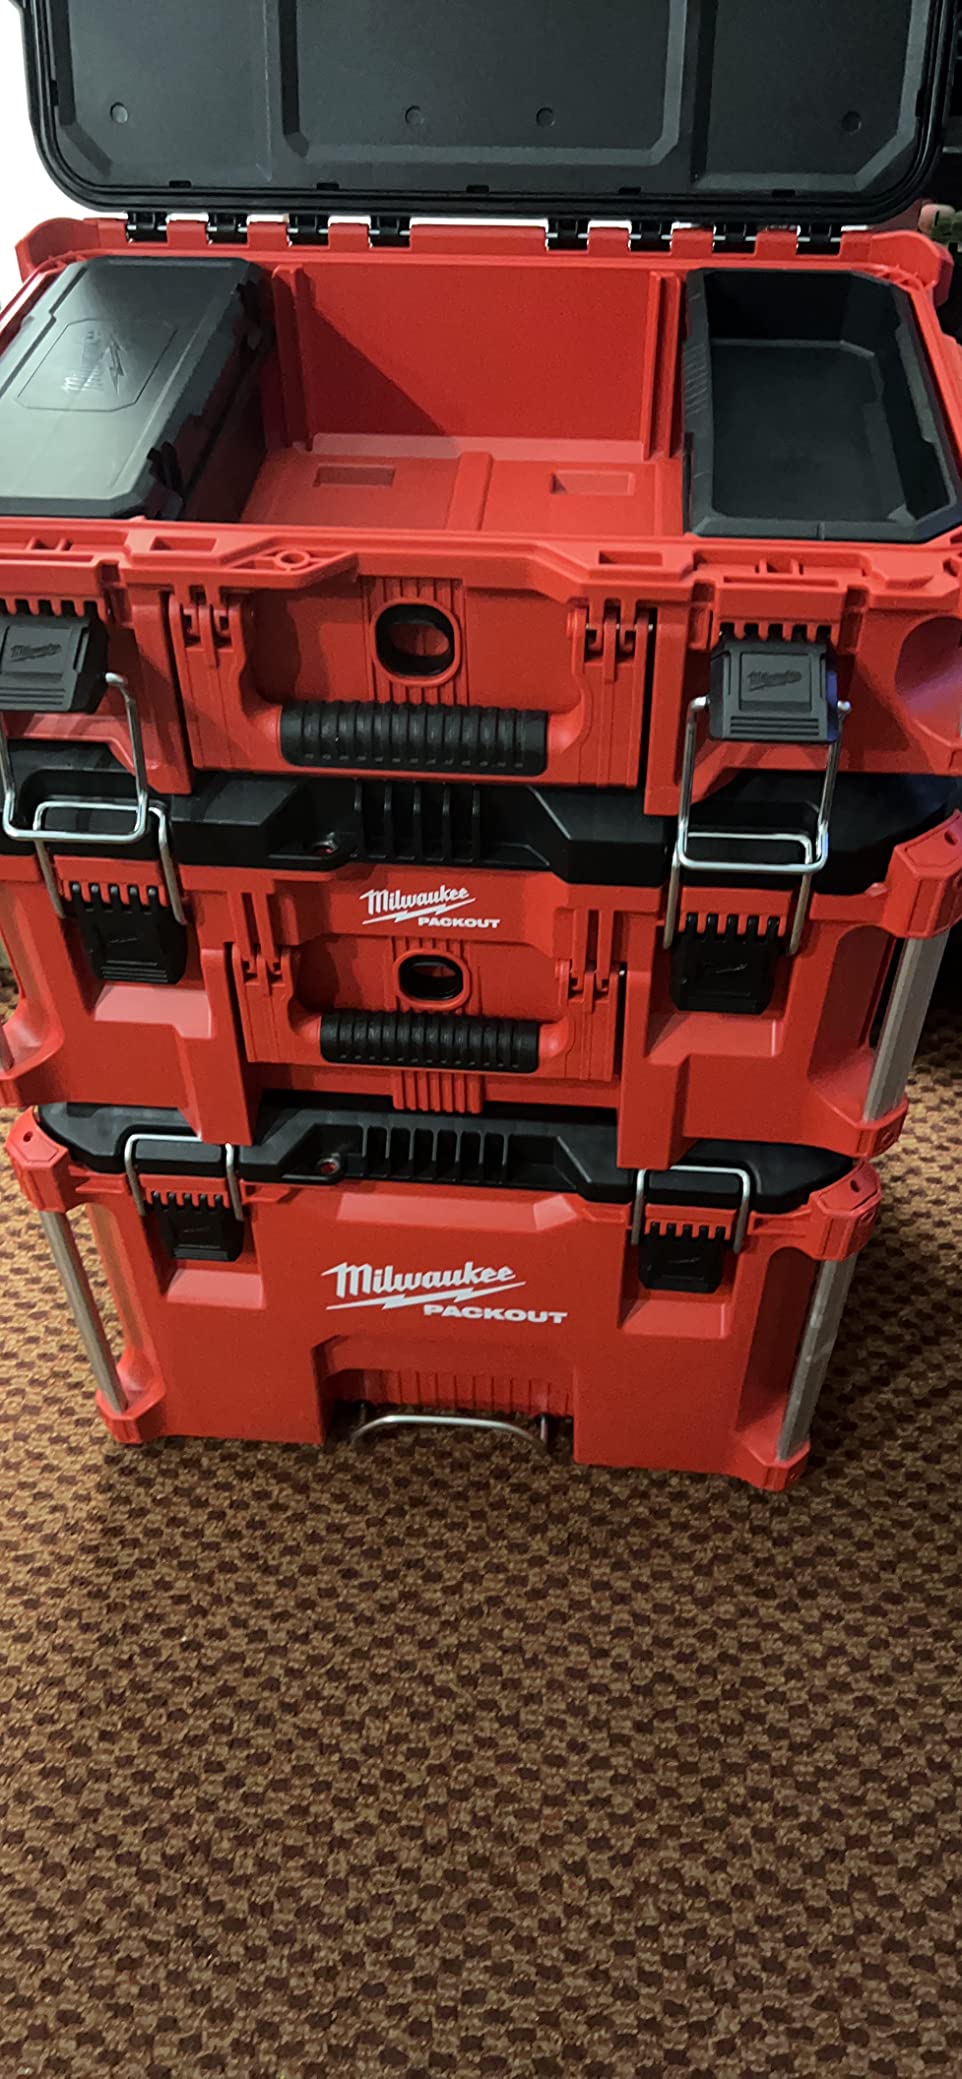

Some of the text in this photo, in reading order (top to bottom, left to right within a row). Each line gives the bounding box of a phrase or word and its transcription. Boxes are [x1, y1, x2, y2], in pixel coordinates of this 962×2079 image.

[359, 884, 470, 915] Milwaukee
[418, 916, 500, 929] PACKOUT
[320, 1261, 517, 1299] Milwaukee
[423, 1304, 568, 1324] PACKOUT
